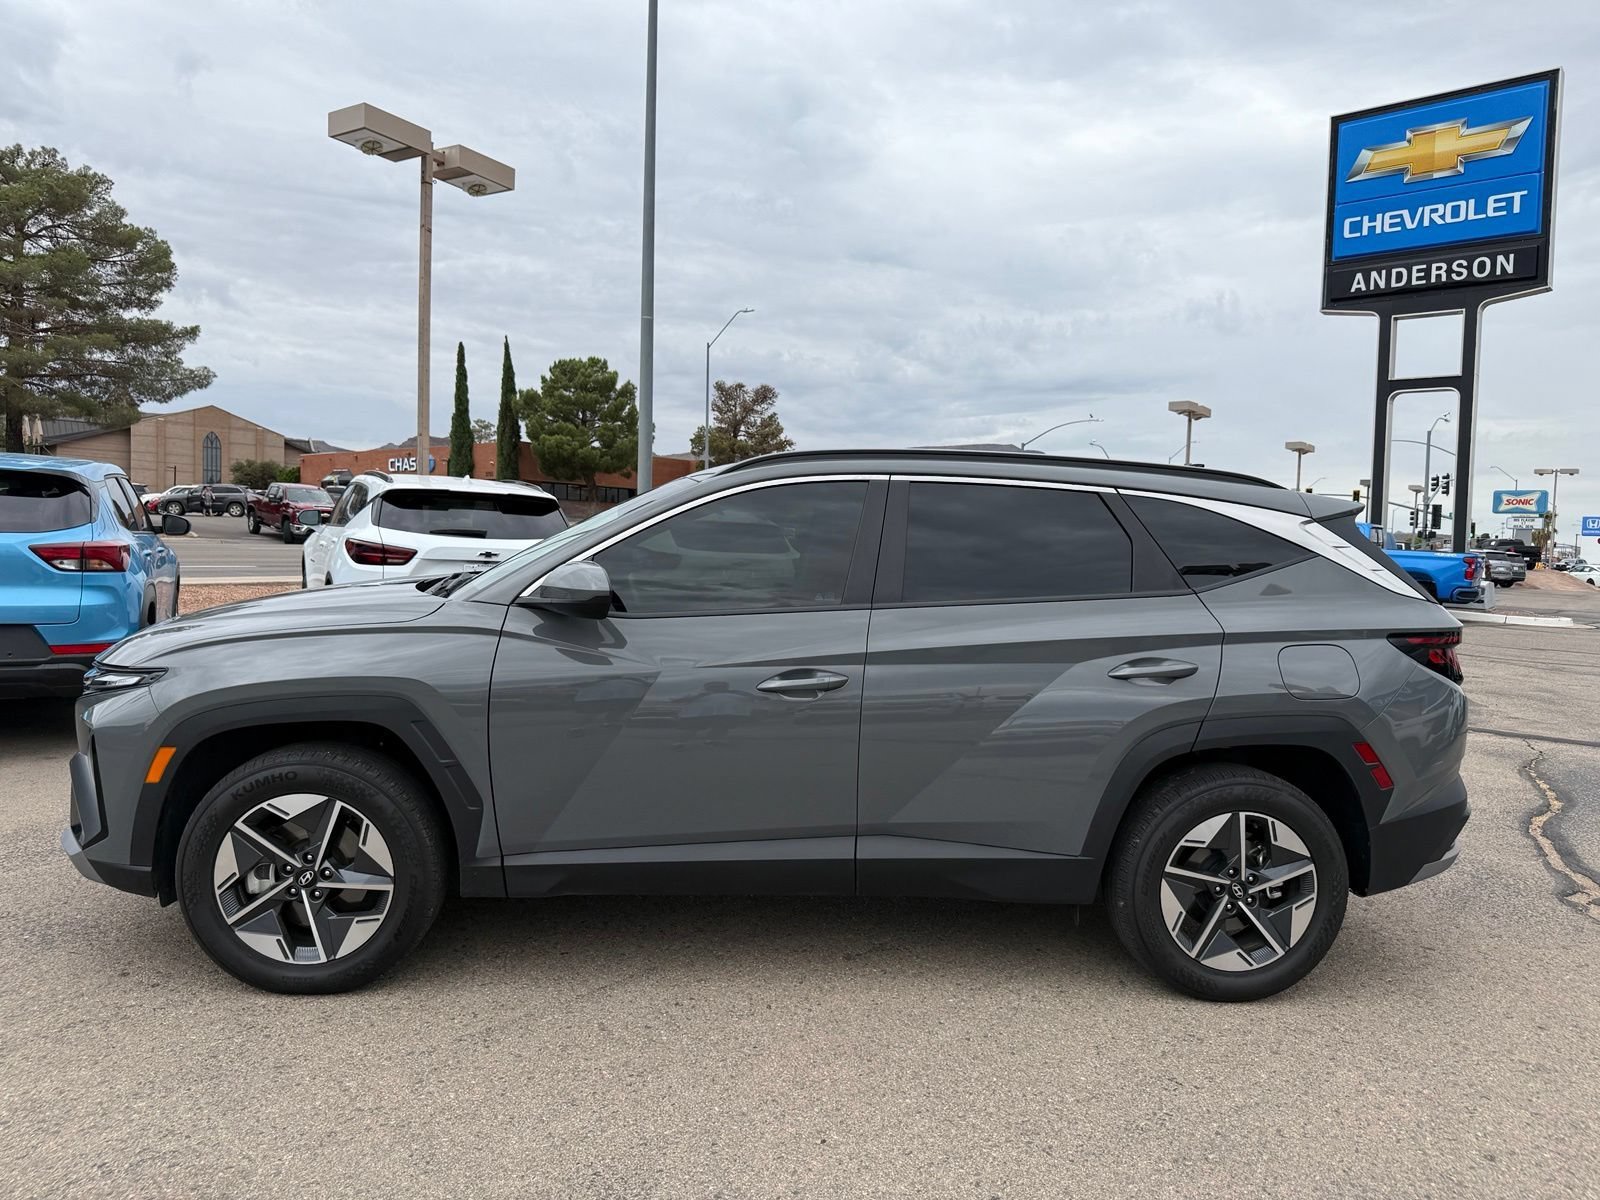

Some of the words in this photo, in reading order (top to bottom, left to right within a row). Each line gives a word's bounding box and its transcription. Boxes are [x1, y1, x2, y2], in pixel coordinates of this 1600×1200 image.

[1343, 190, 1528, 239] CHEVROLET
[1350, 253, 1515, 293] ANDERSON
[388, 457, 417, 472] CHAS
[1504, 498, 1535, 506] SONIC
[230, 770, 298, 801] KUMHO
